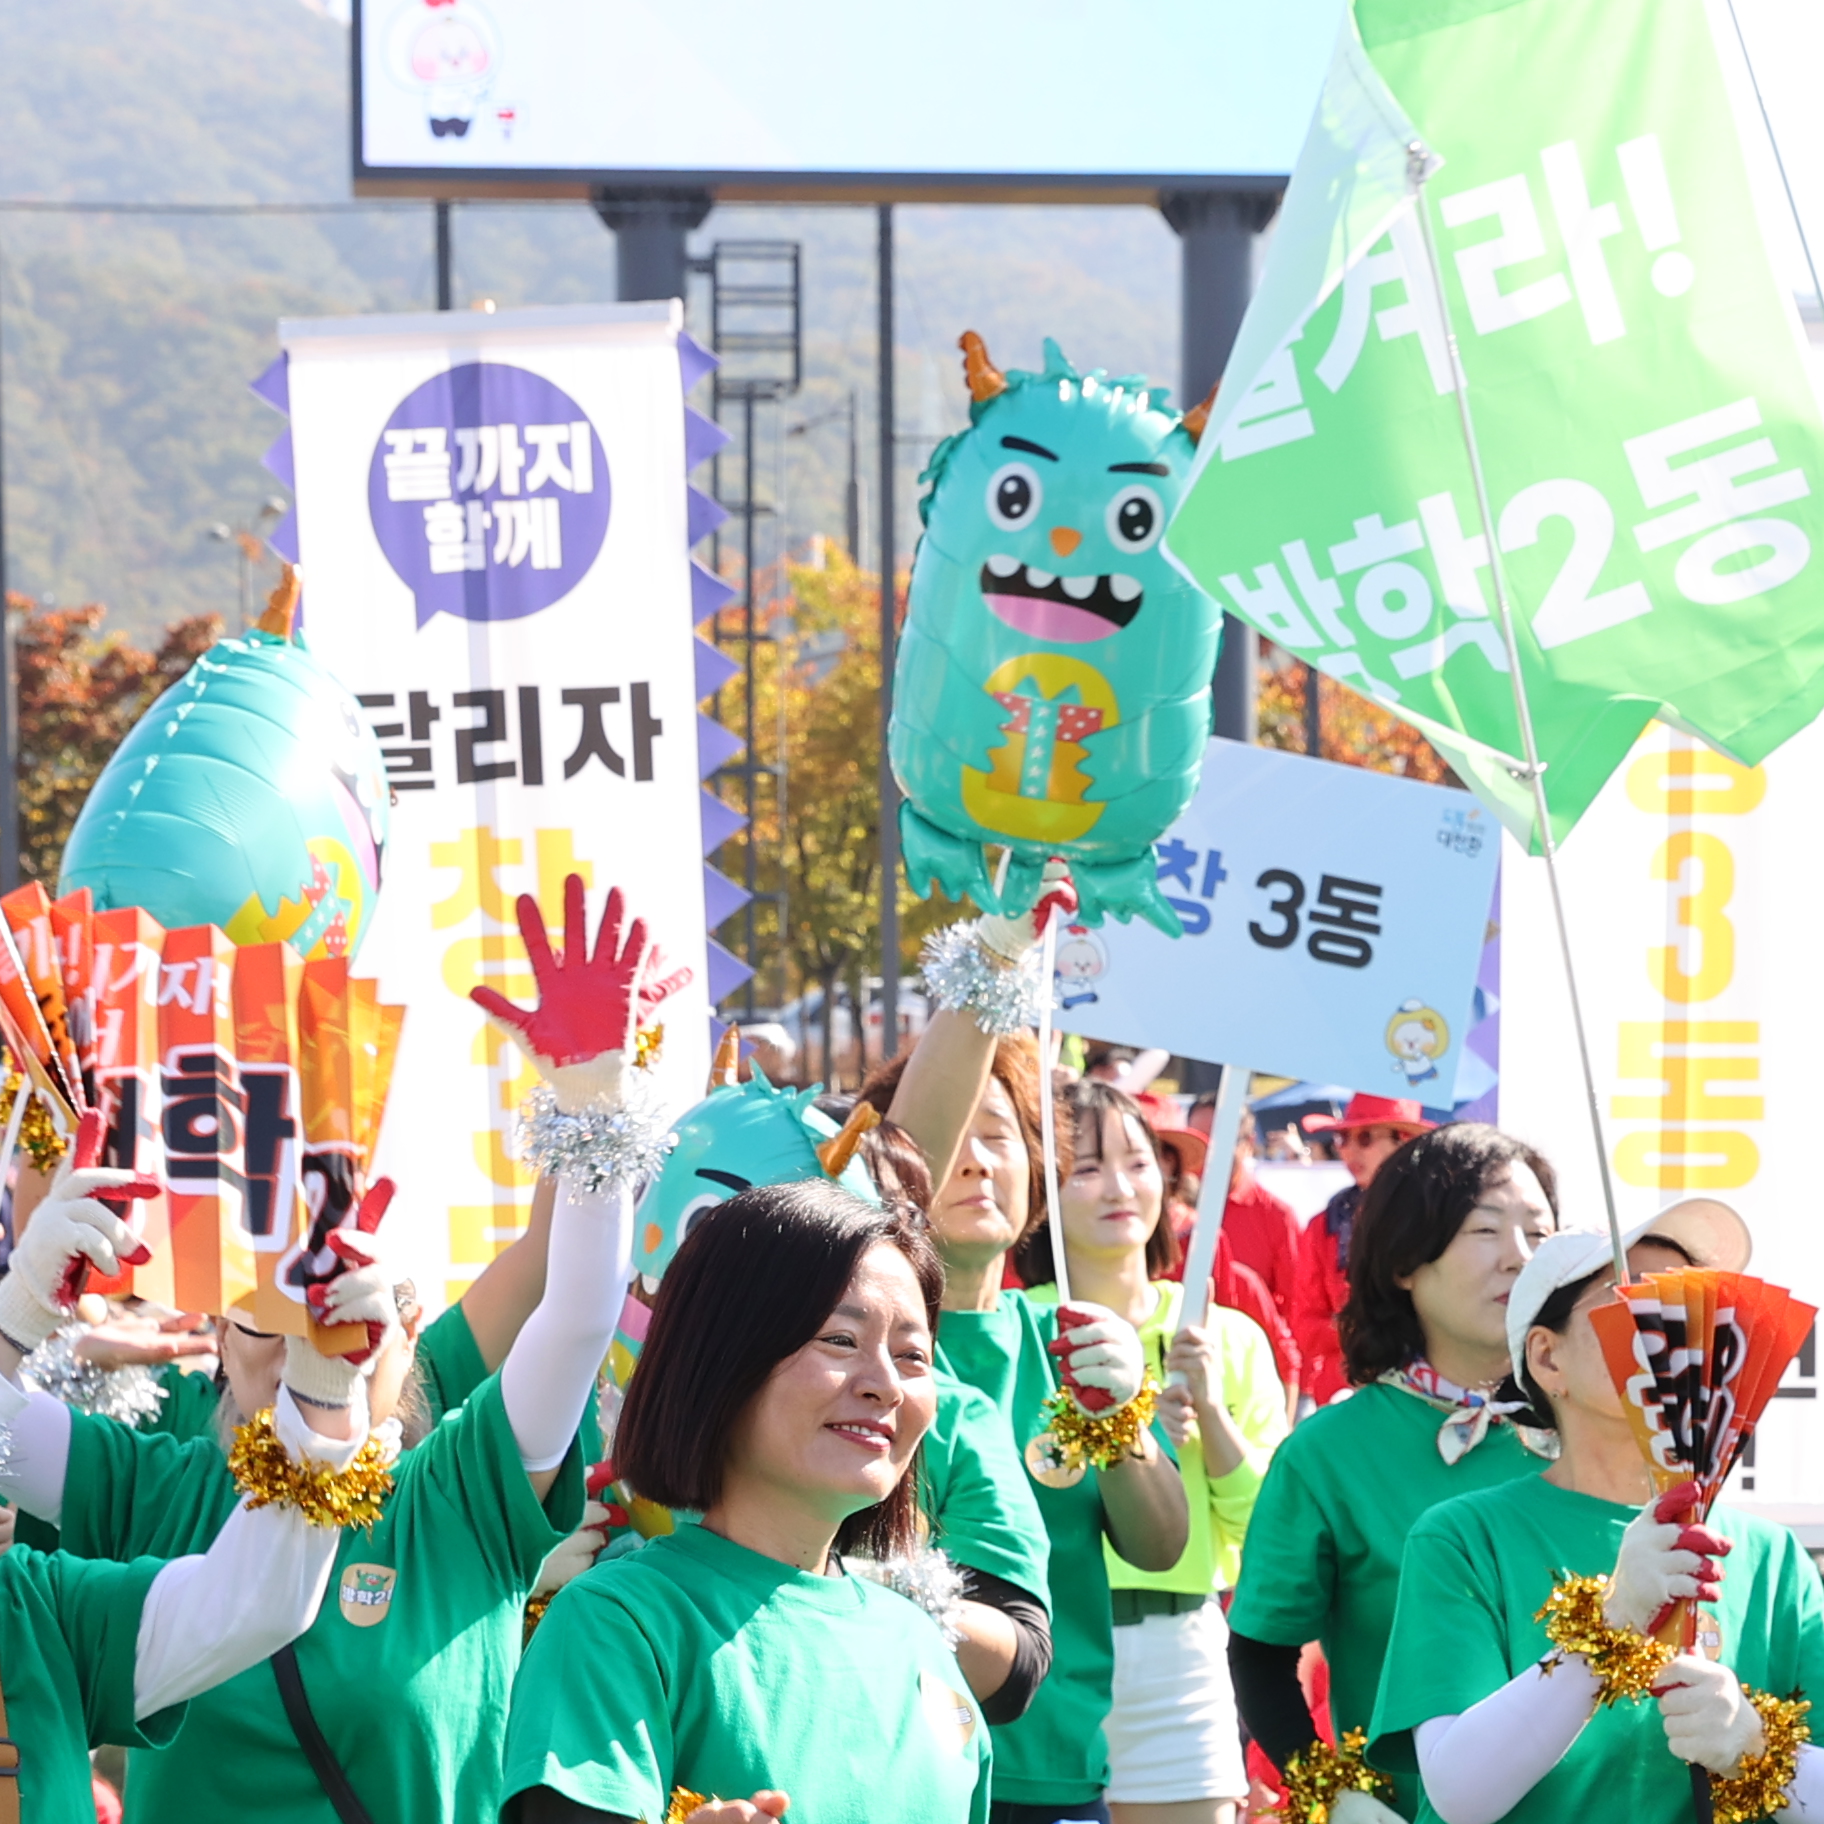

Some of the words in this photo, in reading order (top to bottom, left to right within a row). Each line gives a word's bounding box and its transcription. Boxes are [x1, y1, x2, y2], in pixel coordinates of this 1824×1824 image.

[383, 421, 595, 502] 끝까지
[423, 497, 563, 574] 함께
[359, 681, 664, 790] 달리자
[1248, 867, 1383, 970] 3동
